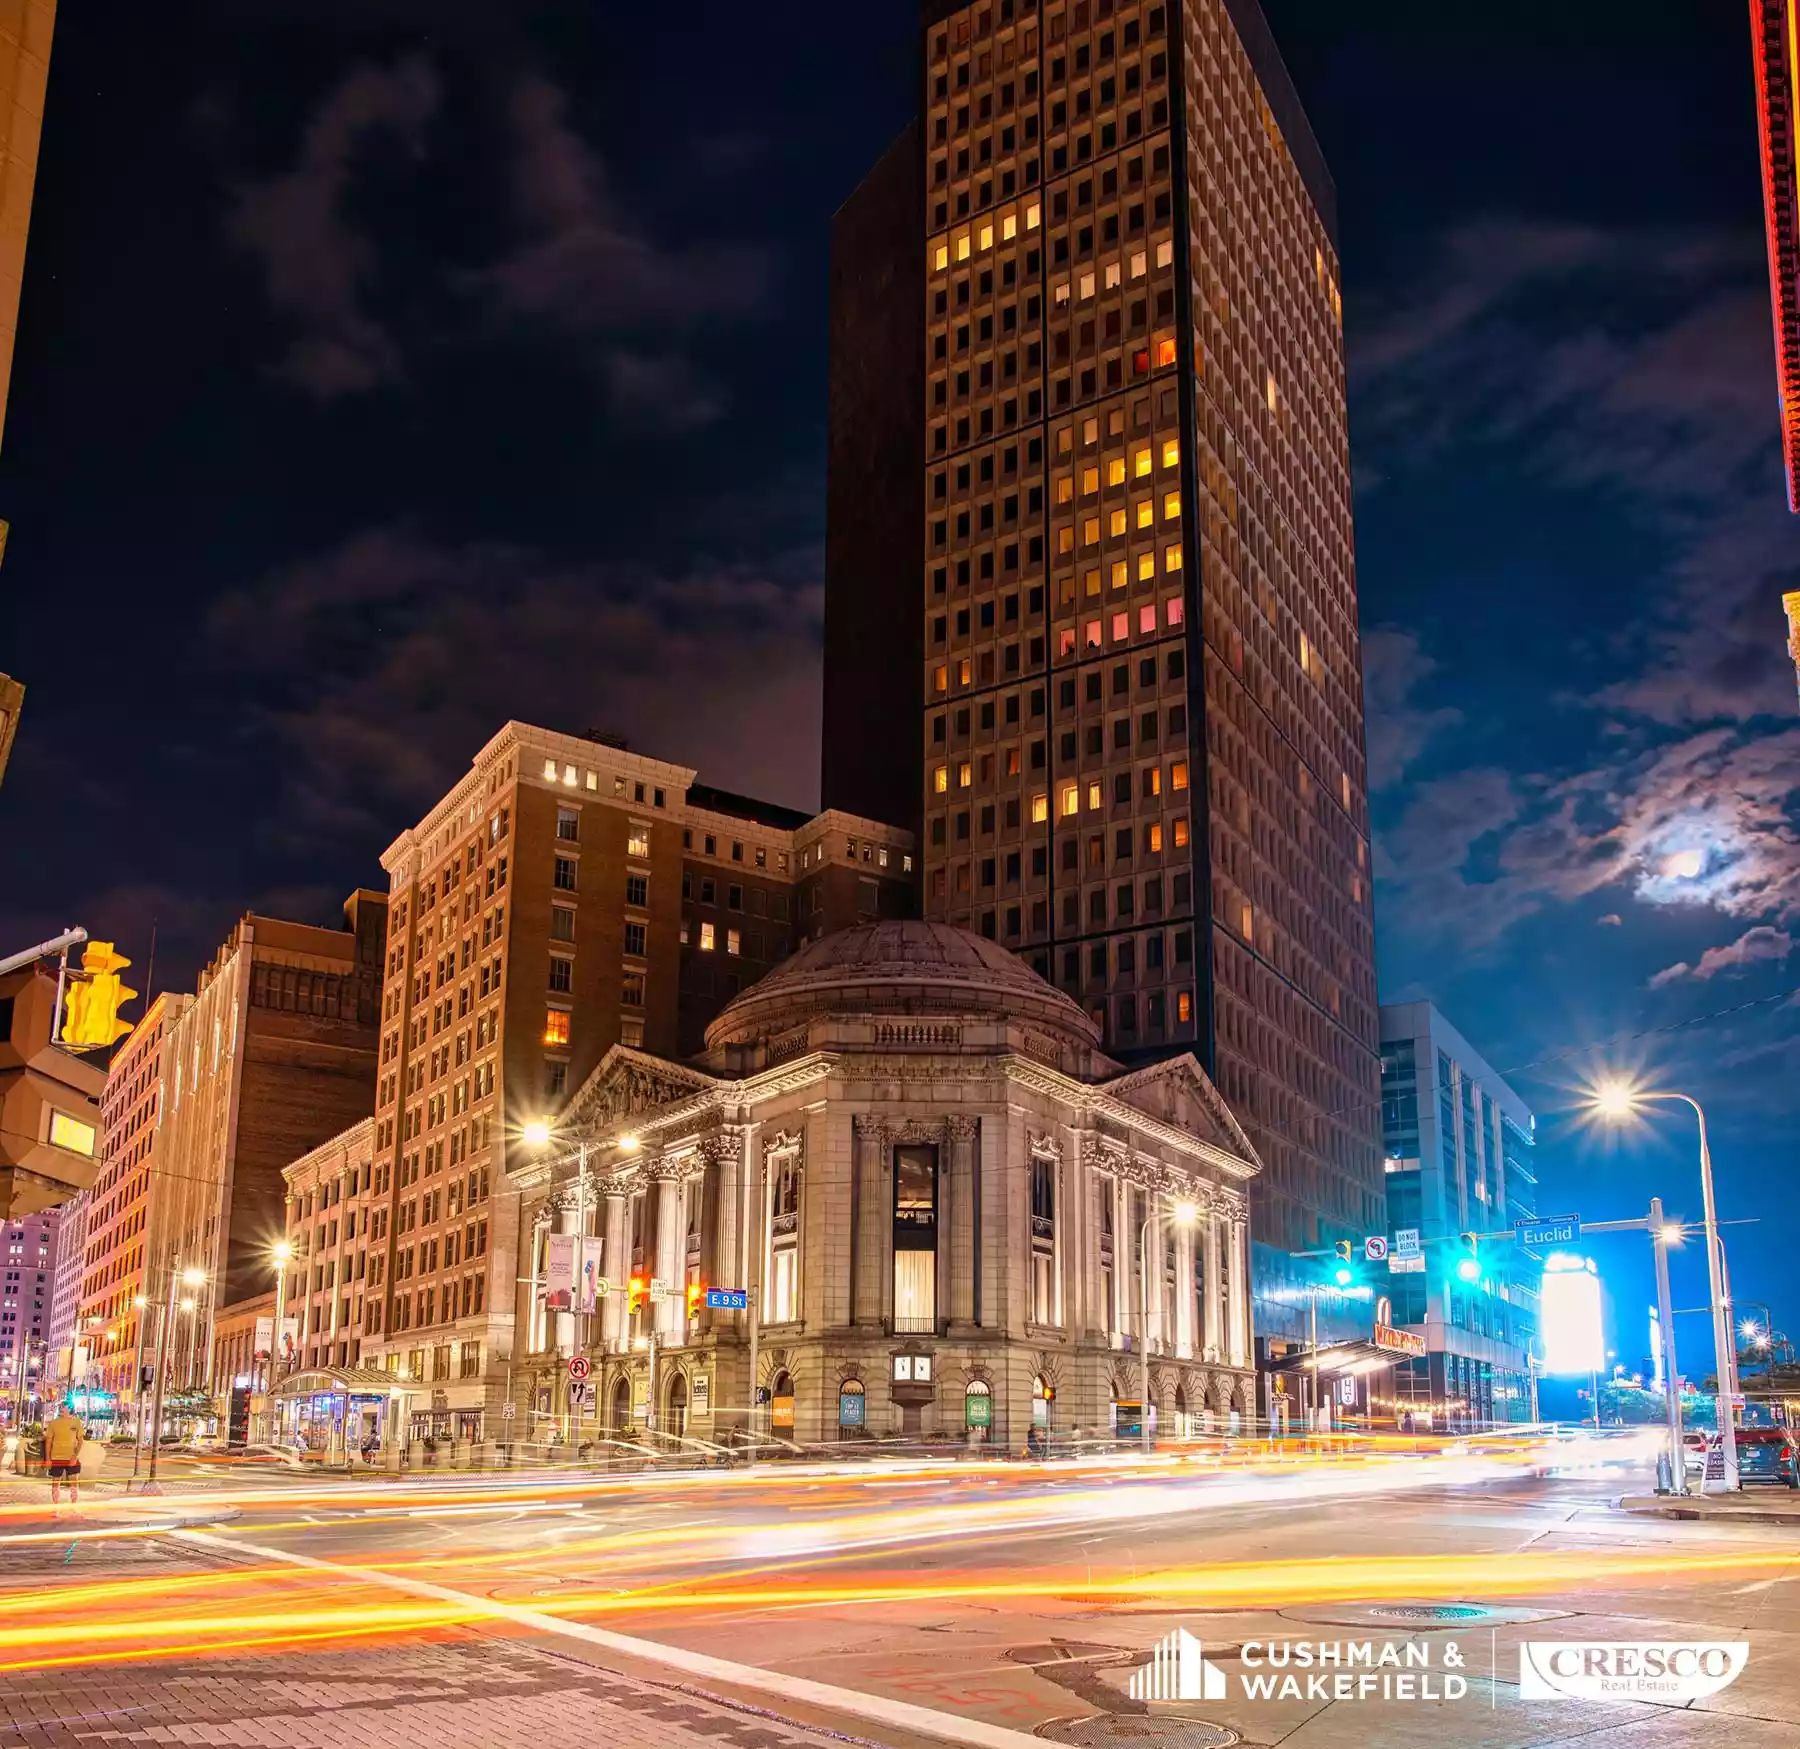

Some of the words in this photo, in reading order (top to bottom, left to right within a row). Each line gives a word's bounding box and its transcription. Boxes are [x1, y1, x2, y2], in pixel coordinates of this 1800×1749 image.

[1405, 1232, 1416, 1241] NOT
[1523, 1225, 1572, 1244] Euclid
[1399, 1242, 1417, 1250] BLOCK
[711, 1295, 720, 1305] E.
[722, 1295, 729, 1305] 9
[731, 1295, 743, 1306] St
[503, 1410, 515, 1418] 25
